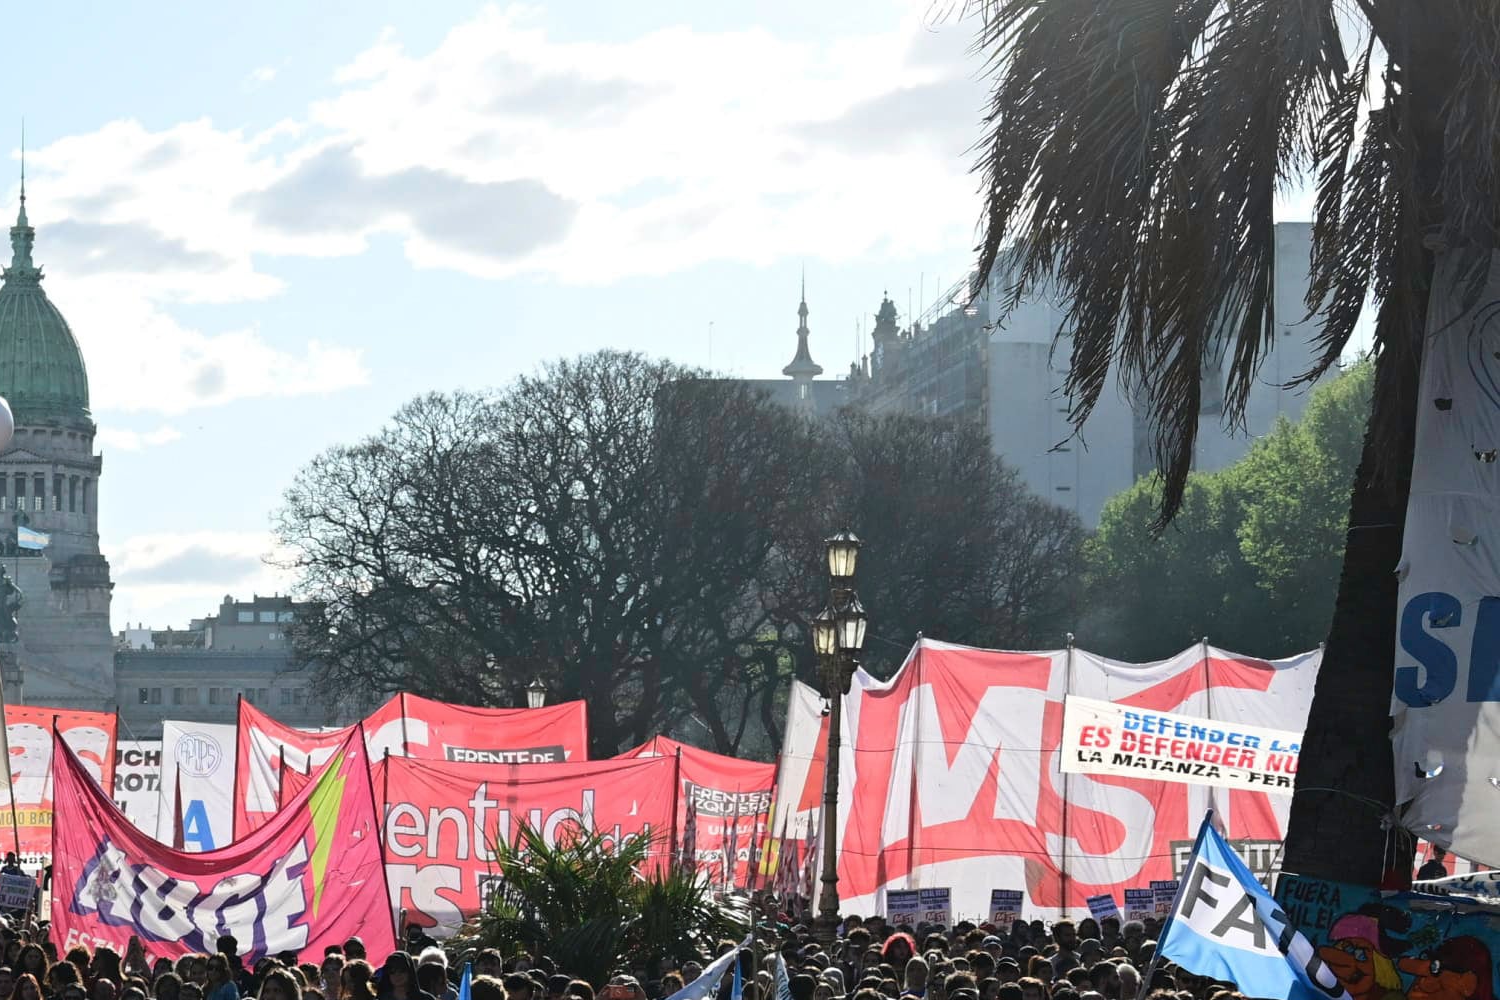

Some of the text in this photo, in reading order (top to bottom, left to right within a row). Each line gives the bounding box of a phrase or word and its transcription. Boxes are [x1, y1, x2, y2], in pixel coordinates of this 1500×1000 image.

[1123, 711, 1261, 749] DEFENDER
[453, 752, 524, 763] FRENTE
[1079, 725, 1112, 748] ES
[1120, 731, 1256, 769] DEFENDER
[1077, 751, 1103, 763] LA
[1112, 753, 1221, 779] MATANZA
[1284, 880, 1341, 908] FUERA
